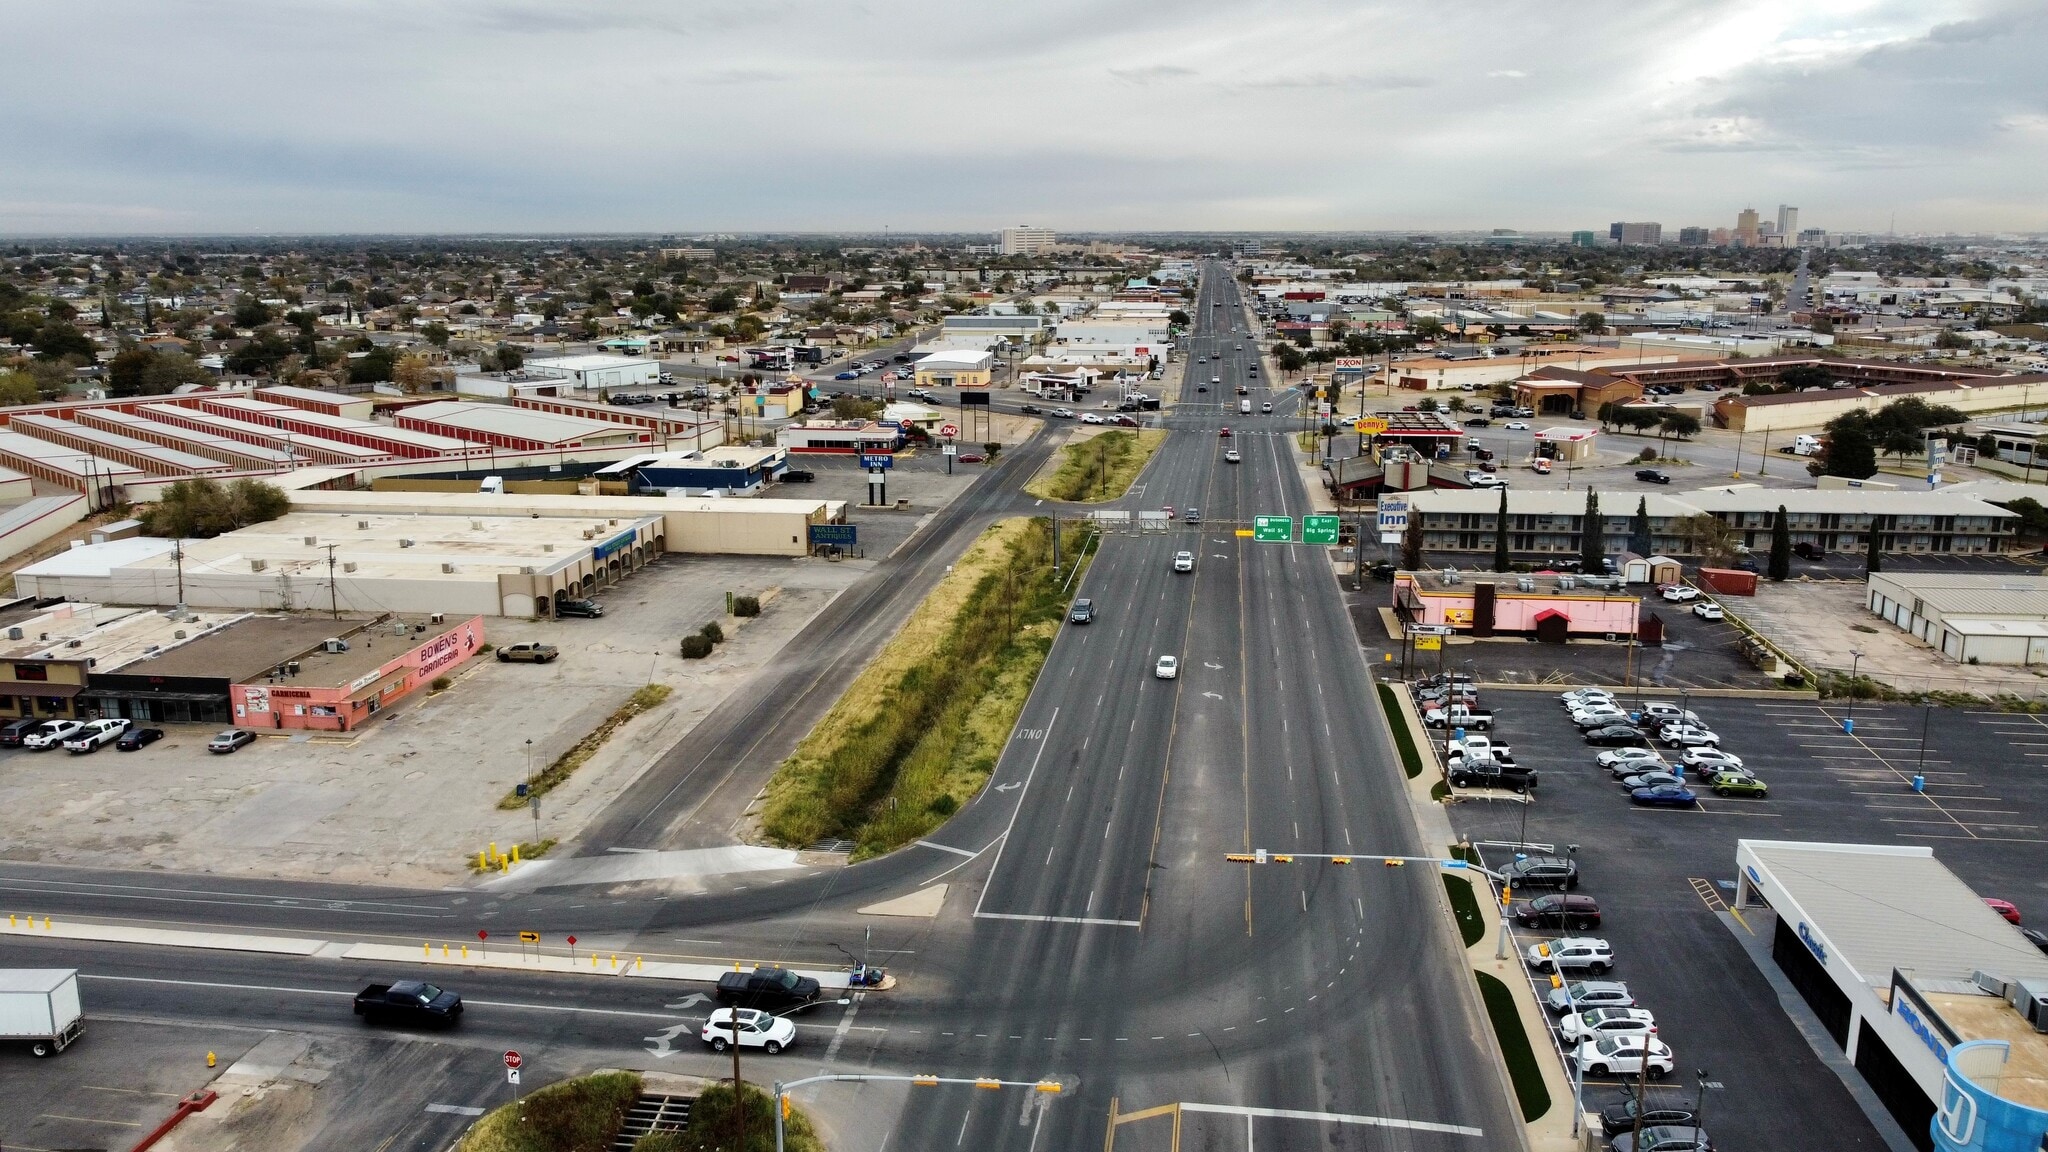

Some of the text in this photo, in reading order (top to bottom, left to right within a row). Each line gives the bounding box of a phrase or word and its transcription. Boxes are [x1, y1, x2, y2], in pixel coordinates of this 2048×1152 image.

[1336, 359, 1361, 367] EXXON
[1357, 421, 1384, 429] Denny's
[1380, 501, 1407, 511] Executive
[1379, 513, 1407, 525] Inn
[813, 526, 838, 534] WALL
[420, 632, 458, 662] BOWEN'S
[418, 648, 459, 678] CARNICERIA
[271, 689, 311, 699] CARNICERIA
[1016, 728, 1043, 740] ONLY
[1896, 997, 1949, 1066] HOND
[504, 1055, 521, 1064] STOP
